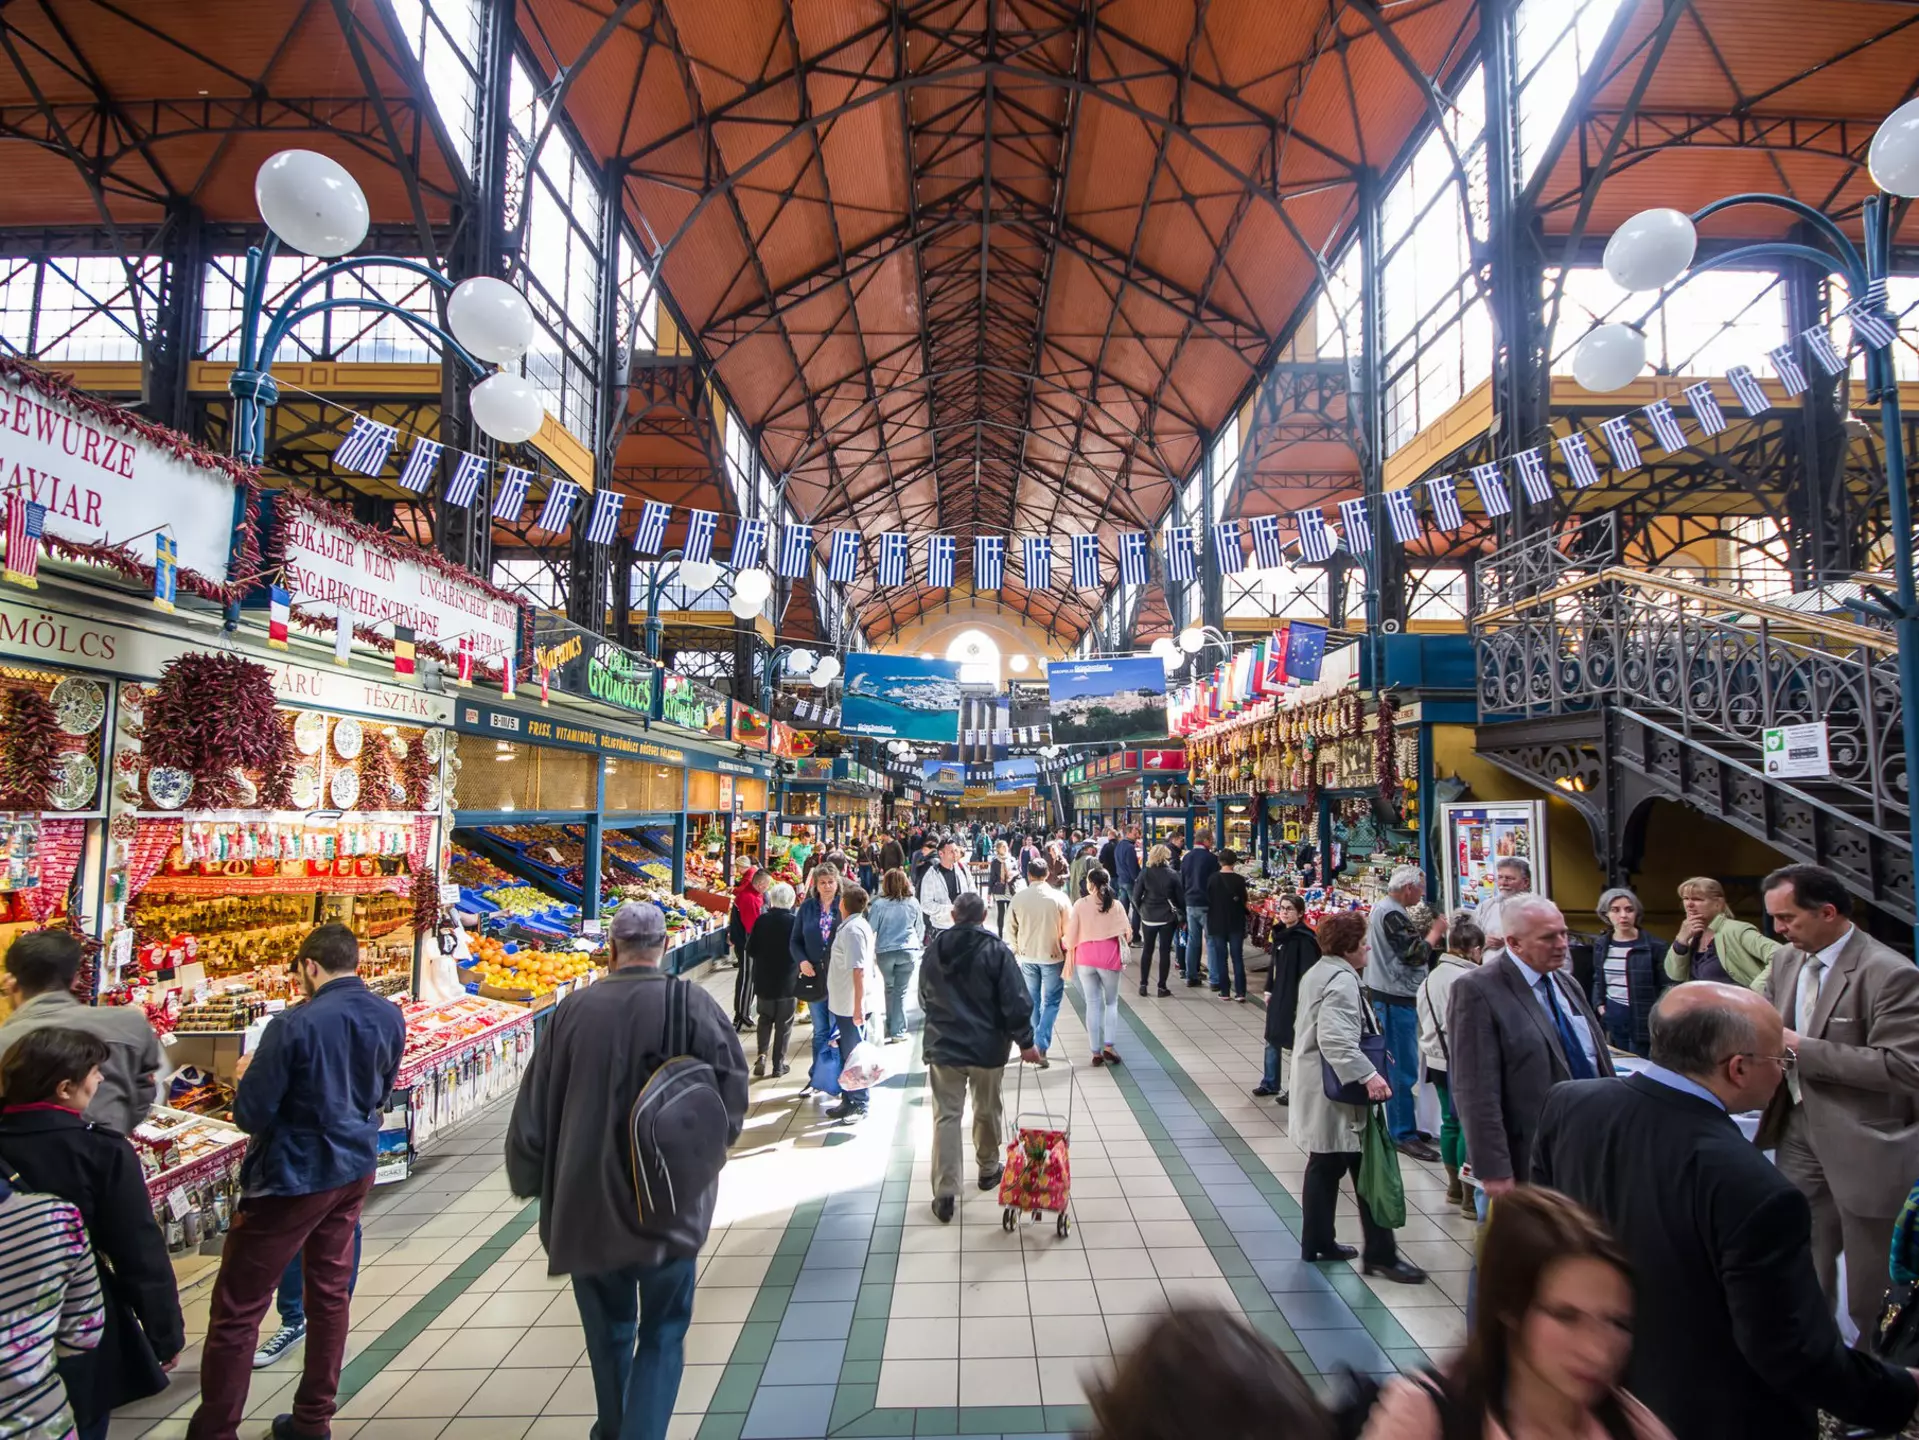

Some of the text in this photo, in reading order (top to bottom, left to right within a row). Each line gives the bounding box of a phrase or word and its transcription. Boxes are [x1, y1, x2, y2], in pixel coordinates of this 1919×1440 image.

[0, 457, 103, 527] AVIAR
[364, 549, 396, 583] WEIN
[290, 565, 440, 638] NGARISCHE-SCHNÄPSE
[420, 573, 488, 620] UNGARISCHER
[0, 612, 116, 660] MÖLCS
[469, 628, 505, 657] SAFRAN
[364, 683, 429, 716] TÉSZTÁK
[528, 720, 552, 739] FRISS,
